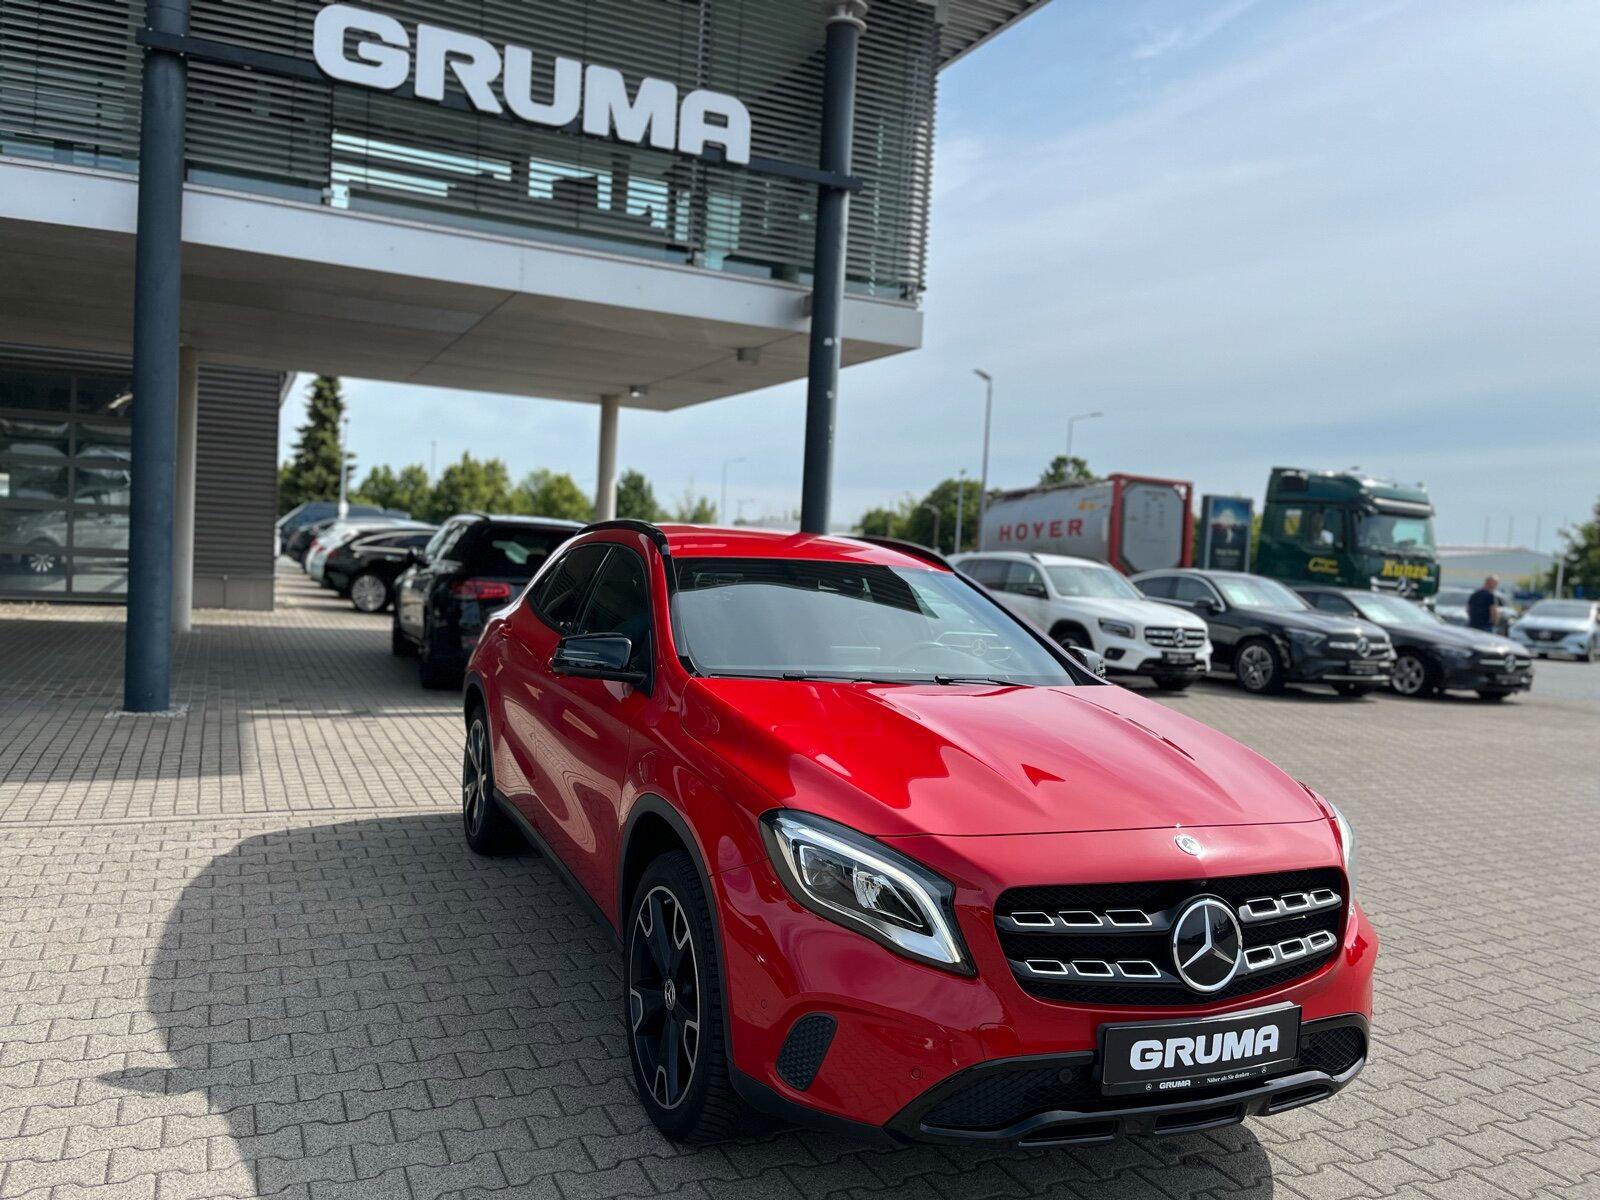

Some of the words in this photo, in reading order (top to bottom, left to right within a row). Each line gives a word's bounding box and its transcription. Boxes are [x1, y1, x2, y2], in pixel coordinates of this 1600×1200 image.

[313, 3, 752, 165] GRUMA
[998, 518, 1084, 542] HOYER
[1129, 1024, 1279, 1071] GRUMA
[1159, 1079, 1191, 1090] GRUMA
